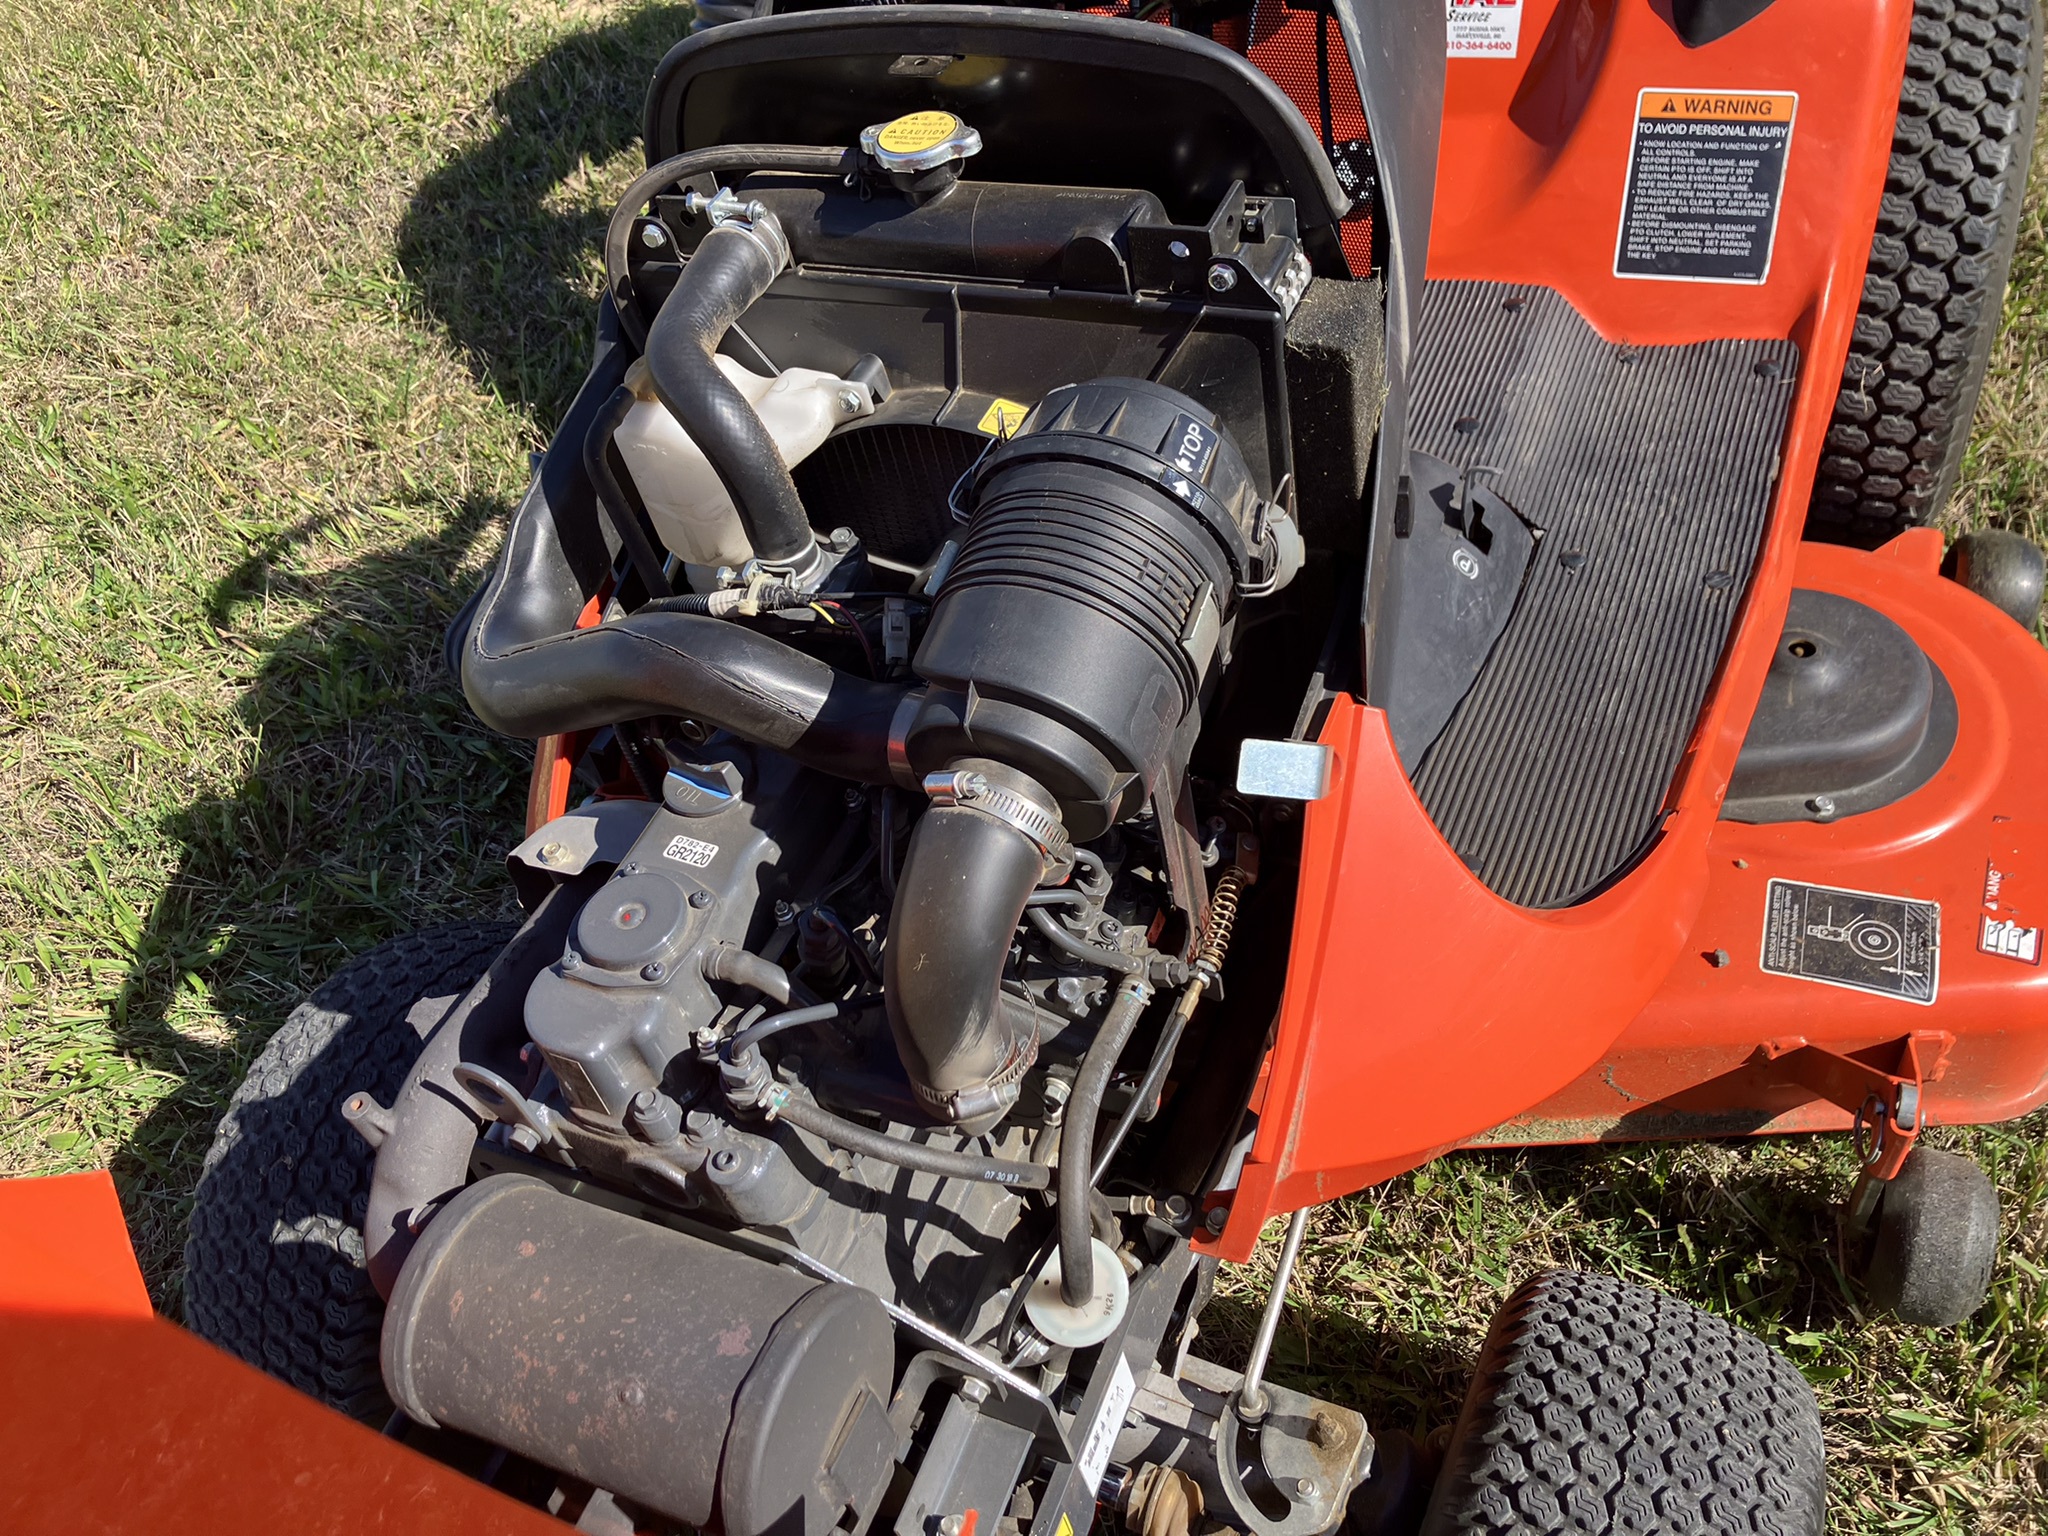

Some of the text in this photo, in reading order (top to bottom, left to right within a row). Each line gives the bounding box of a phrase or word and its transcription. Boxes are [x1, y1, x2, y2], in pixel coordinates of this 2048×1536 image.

[1685, 98, 1772, 115] WARNING
[1639, 122, 1788, 138] TO AVOID PERSONAL INJURY
[1641, 148, 1654, 156] ALL
[1643, 140, 1770, 152] KNOW LOCATION AND FUNCTION OF
[1640, 156, 1670, 164] BEFORE
[1671, 156, 1706, 166] STARTING
[1738, 159, 1760, 168] MAKE
[1639, 164, 1670, 172] CERTAIN
[1671, 165, 1686, 173] PTO
[1687, 166, 1695, 174] IS
[1713, 166, 1735, 174] SHIFT
[1736, 167, 1754, 176] INTO
[1638, 172, 1670, 180] NEUTRAL
[1688, 174, 1728, 182] EVERYONE
[1728, 174, 1736, 183] IS
[1737, 175, 1747, 183] AT
[1747, 176, 1753, 184] A
[1636, 180, 1656, 188] SAFE
[1656, 180, 1692, 190] DISTANCE
[1693, 182, 1714, 190] FROM
[1636, 188, 1646, 196] TO
[1647, 188, 1677, 197] REDUCE
[1678, 190, 1695, 198] FIRE
[1733, 191, 1754, 200] KEEP
[1754, 192, 1770, 200] THE
[1634, 196, 1668, 204] EXHAUST
[1668, 197, 1688, 206] WELL
[1689, 198, 1714, 206] CLEAR
[1716, 199, 1728, 207] OF
[1728, 199, 1744, 208] DRY
[1633, 204, 1768, 217] DRY LEAVES OR OTHER COMBUSTIBLE
[1631, 220, 1660, 228] BEFORE
[1714, 222, 1757, 232] DISENGAGE
[1630, 228, 1644, 236] PTO
[1677, 230, 1703, 238] LOWER
[1628, 236, 1650, 244] SHIFT
[1650, 236, 1668, 244] INTO
[1704, 238, 1719, 247] SET
[1720, 240, 1752, 248] PARKING
[1641, 252, 1657, 260] KEY
[1654, 244, 1674, 252] STOP
[1674, 245, 1702, 254] ENGINE
[1702, 246, 1718, 255] AND
[1719, 248, 1750, 256] REMOVE
[1178, 422, 1204, 460] TOP
[676, 786, 702, 807] OIL
[676, 836, 716, 853] D782-E4
[666, 844, 711, 866] GR2120
[1772, 885, 1782, 910] SETTING
[1770, 910, 1780, 932] ROLLER
[1112, 1002, 1140, 1050] FUEL/EMISSION
[984, 1170, 996, 1180] 07
